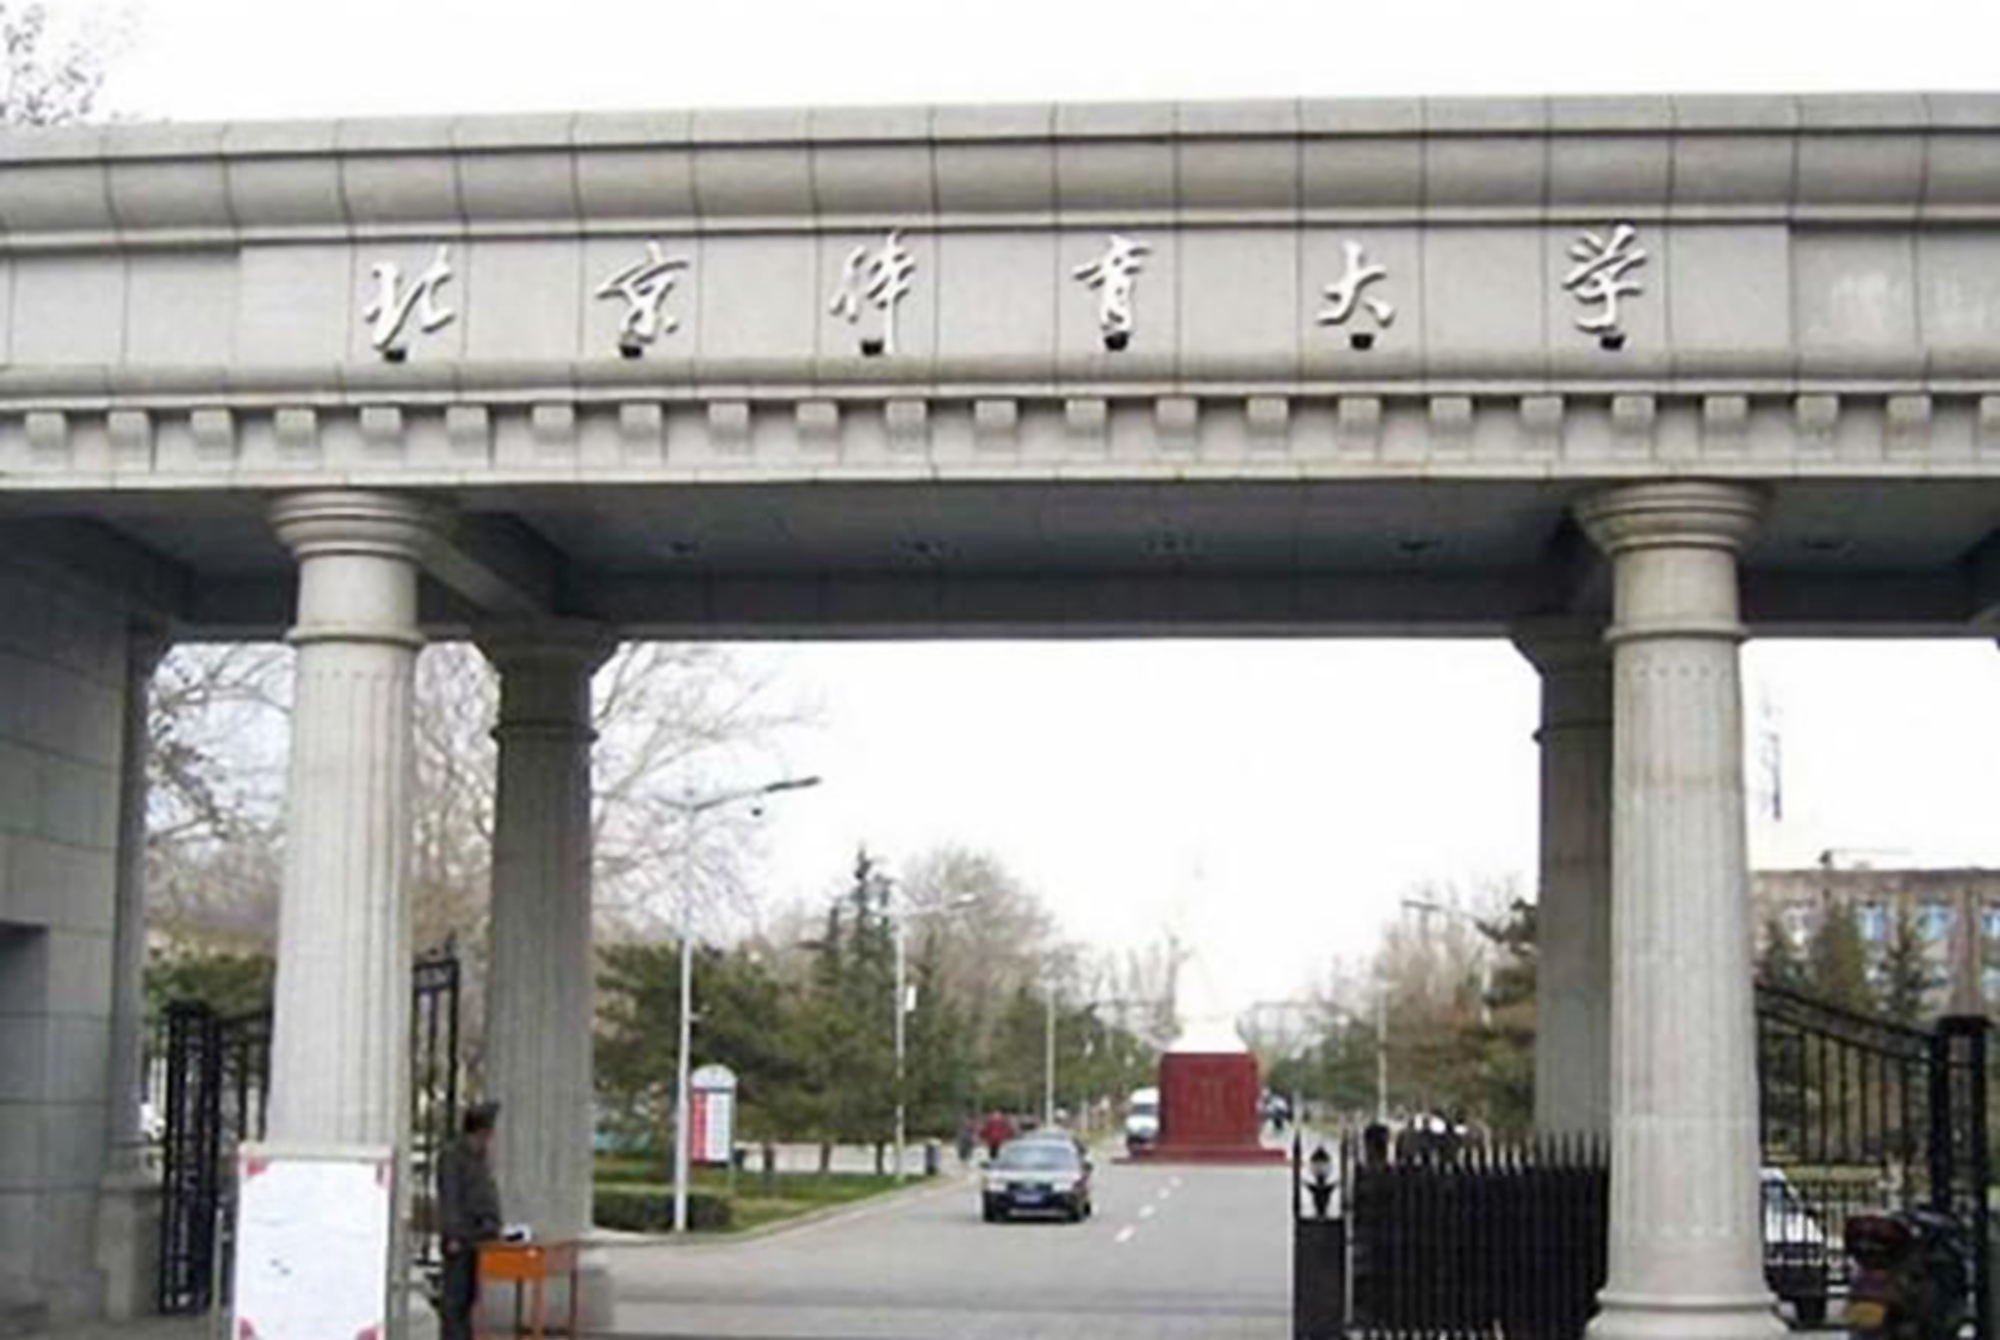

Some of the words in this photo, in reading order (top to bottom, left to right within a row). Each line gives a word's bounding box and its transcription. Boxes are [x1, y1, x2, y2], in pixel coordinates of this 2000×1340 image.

[364, 224, 1647, 352] 北京体育大学
